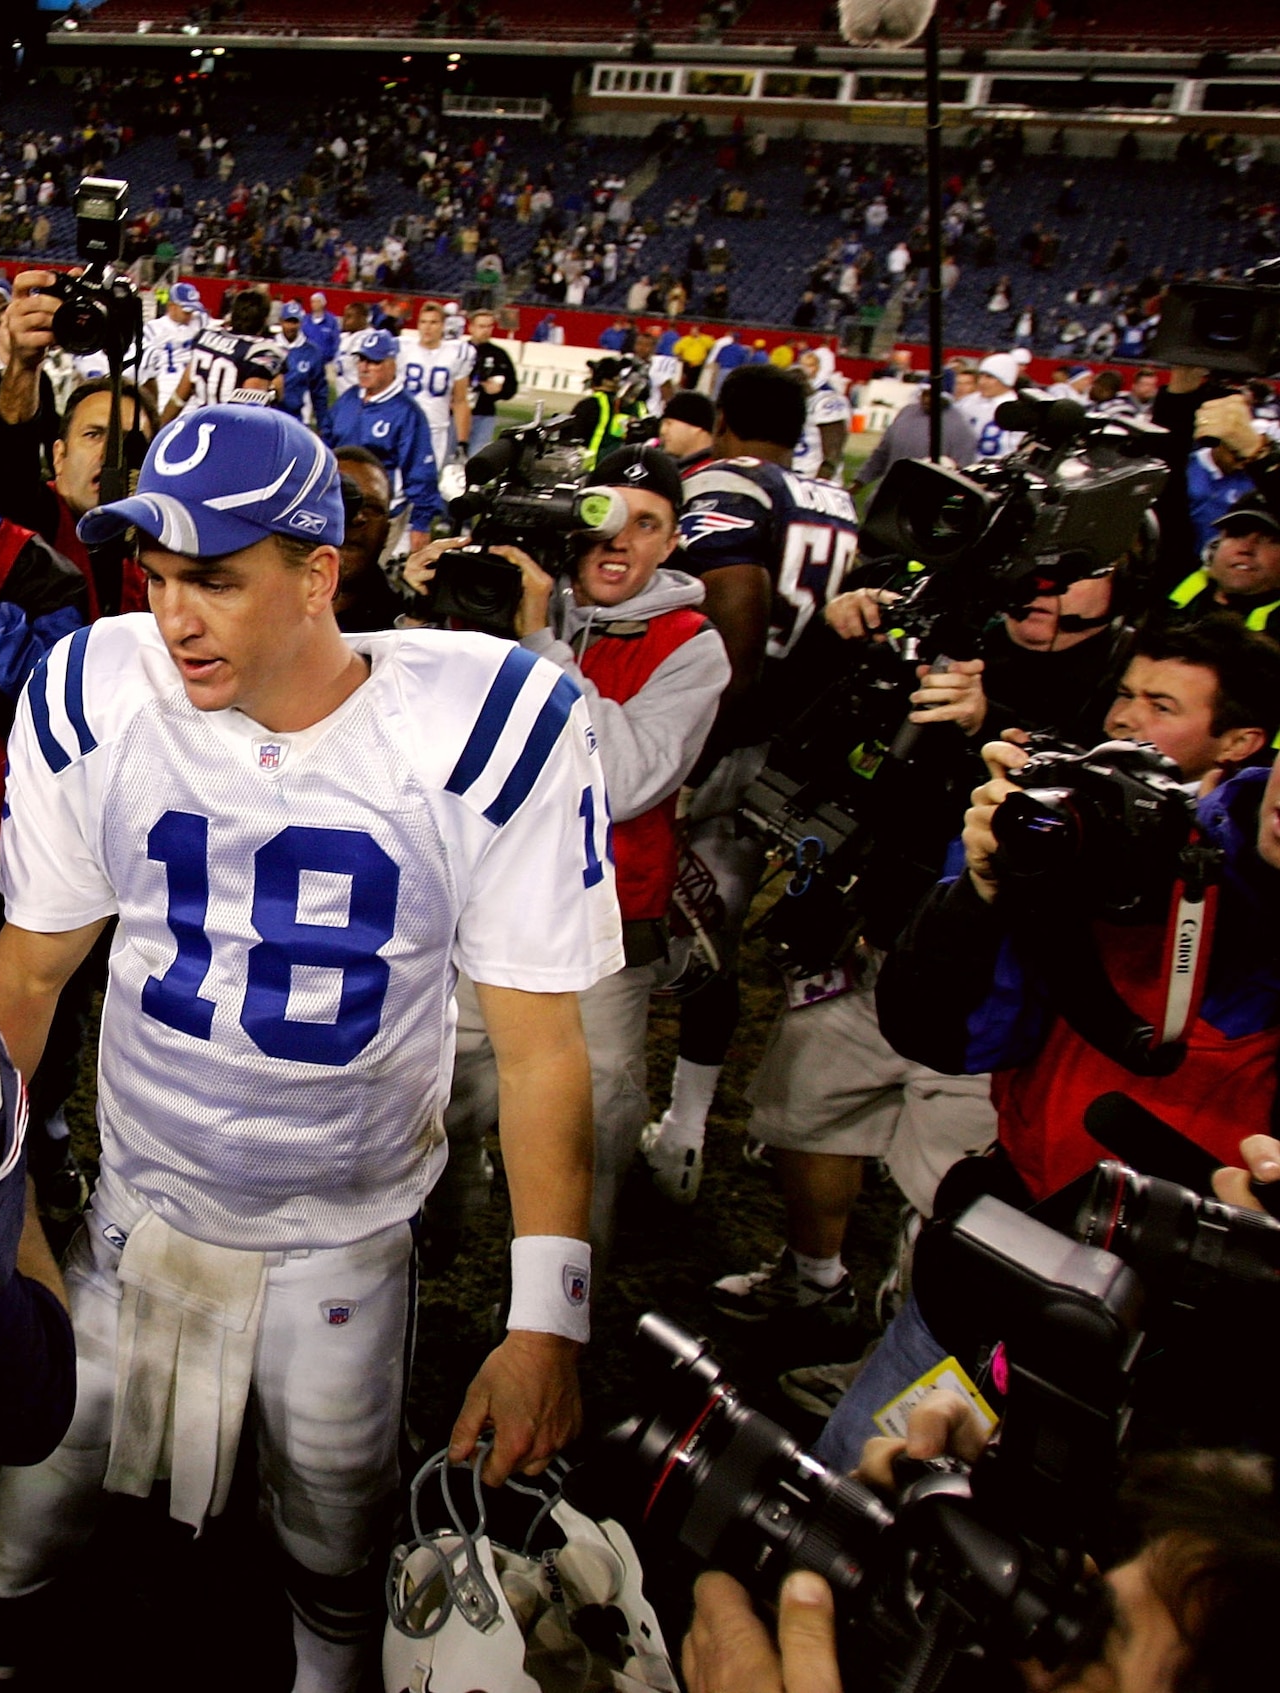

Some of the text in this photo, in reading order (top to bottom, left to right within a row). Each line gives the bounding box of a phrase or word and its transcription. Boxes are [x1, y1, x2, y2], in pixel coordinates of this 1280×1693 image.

[189, 348, 238, 404] 50
[404, 362, 451, 397] 80
[577, 784, 616, 890] 1
[141, 809, 401, 1067] 18
[1175, 918, 1197, 974] Canon
